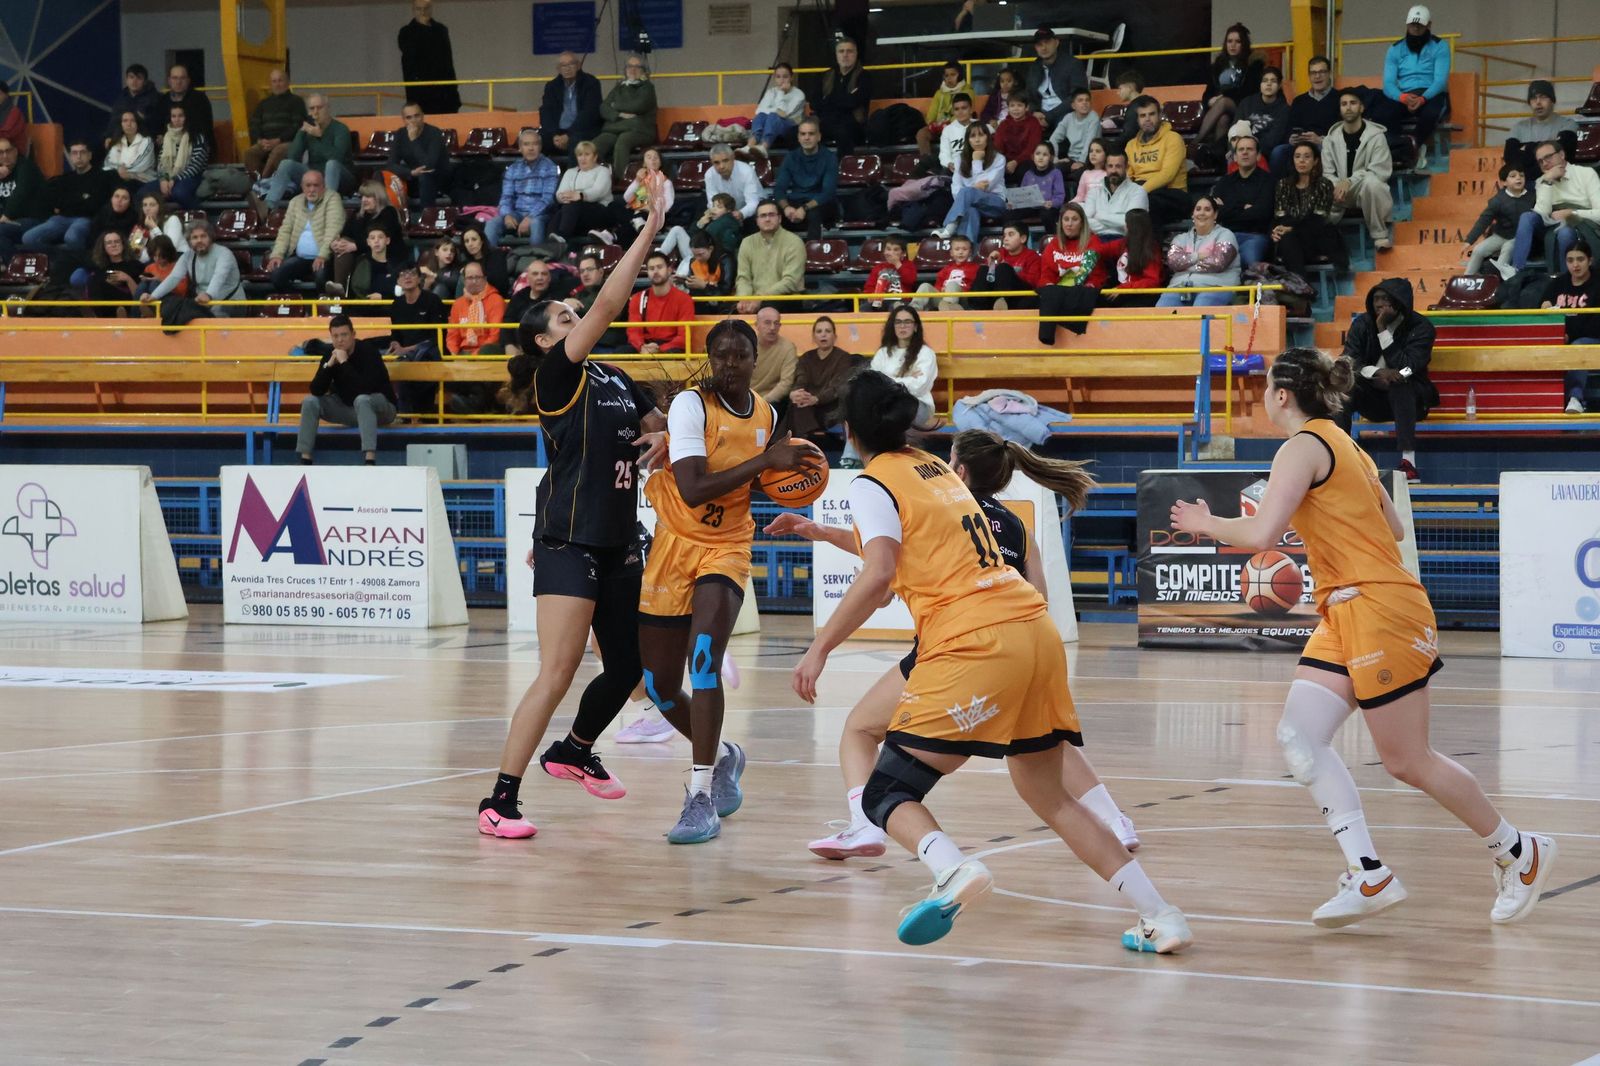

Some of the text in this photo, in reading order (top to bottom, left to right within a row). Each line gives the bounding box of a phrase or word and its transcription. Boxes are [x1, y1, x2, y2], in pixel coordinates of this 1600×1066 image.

[856, 159, 864, 169] 7
[1419, 228, 1464, 244] FILA
[1465, 278, 1485, 291] 27
[615, 460, 632, 489] 25
[777, 471, 821, 493] Wilson
[822, 499, 837, 510] E.S.
[700, 503, 724, 528] 23
[961, 513, 998, 568] 11
[231, 575, 264, 584] Avenida
[266, 576, 284, 585] Tres
[286, 576, 316, 585] Cruces
[318, 577, 327, 585] 17
[329, 577, 347, 586] Entr
[361, 578, 386, 587] 49008
[388, 578, 420, 588] Zamora
[1155, 564, 1242, 590] COMPITE
[69, 573, 126, 598] salud
[1156, 590, 1242, 602] SIN MIEDOS
[252, 604, 273, 617] 980
[276, 605, 290, 617] 05
[293, 605, 308, 618] 85
[311, 606, 325, 618] 90
[336, 606, 358, 619] 605
[361, 607, 376, 619] 76
[379, 607, 392, 620] 71
[396, 608, 411, 620] 05
[1156, 626, 1314, 637] TENEMOS LOS MEJORES EQUIPOS
